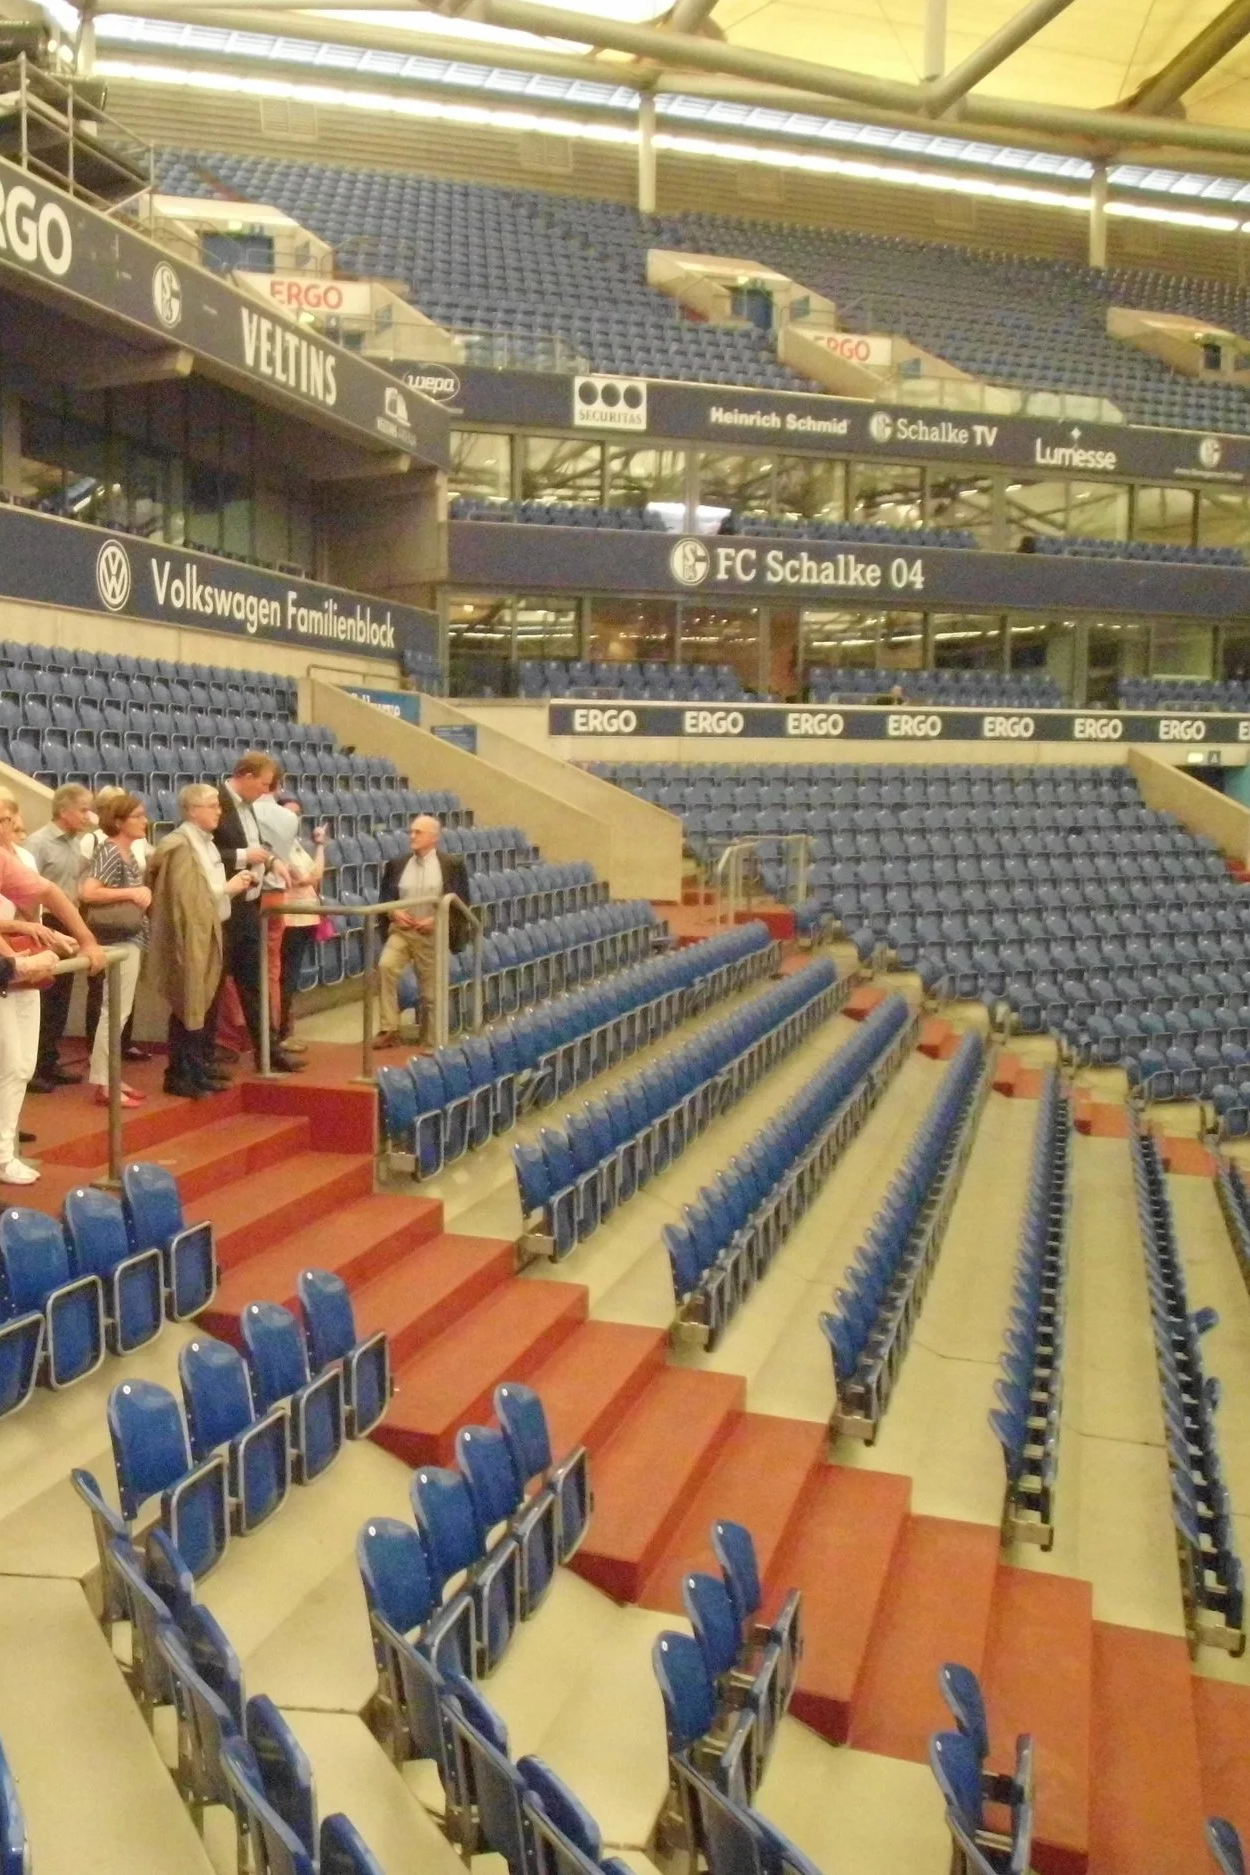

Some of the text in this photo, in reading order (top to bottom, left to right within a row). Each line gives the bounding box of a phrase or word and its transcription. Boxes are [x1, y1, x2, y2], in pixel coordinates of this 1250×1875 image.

[270, 280, 343, 309] ERGO
[241, 306, 338, 406] VELTINS
[579, 408, 643, 424] SECURITAS
[710, 406, 848, 435] Heinrich Schmid
[897, 418, 998, 446] Schalke TV
[1035, 437, 1117, 470] Lumesse
[716, 548, 925, 589] FC Schalke 04
[151, 558, 395, 649] Volkswagen Familienblock
[574, 709, 638, 733] ERGO
[684, 711, 744, 734] ERGO
[787, 713, 844, 735] ERGO
[887, 714, 942, 737] ERGO
[983, 716, 1035, 738] ERGO
[1073, 718, 1123, 739] ERGO
[1159, 720, 1206, 740] ERGO
